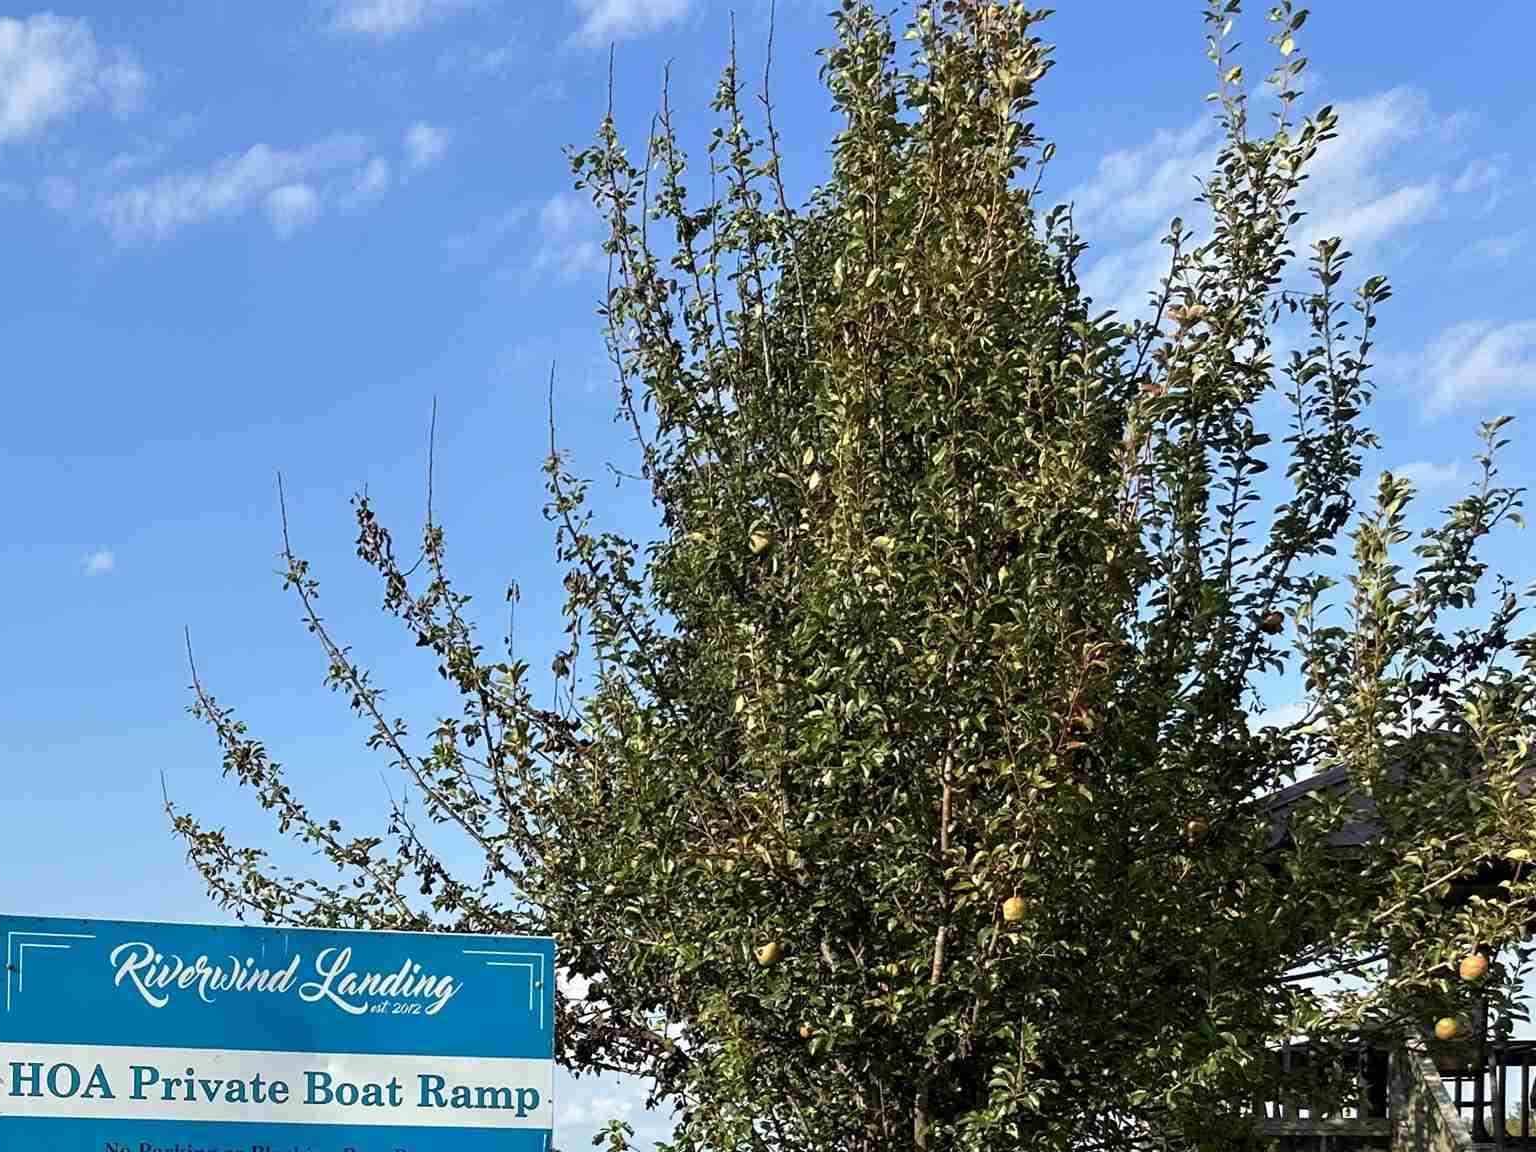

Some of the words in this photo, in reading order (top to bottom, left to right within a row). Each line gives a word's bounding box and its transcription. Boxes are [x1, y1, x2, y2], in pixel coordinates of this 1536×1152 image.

[110, 942, 300, 1007] Riverwind
[299, 947, 463, 1015] Landing
[8, 1062, 115, 1098] HOA
[129, 1065, 289, 1104] Private
[303, 1072, 403, 1107] Boat
[417, 1074, 540, 1117] Ramp
